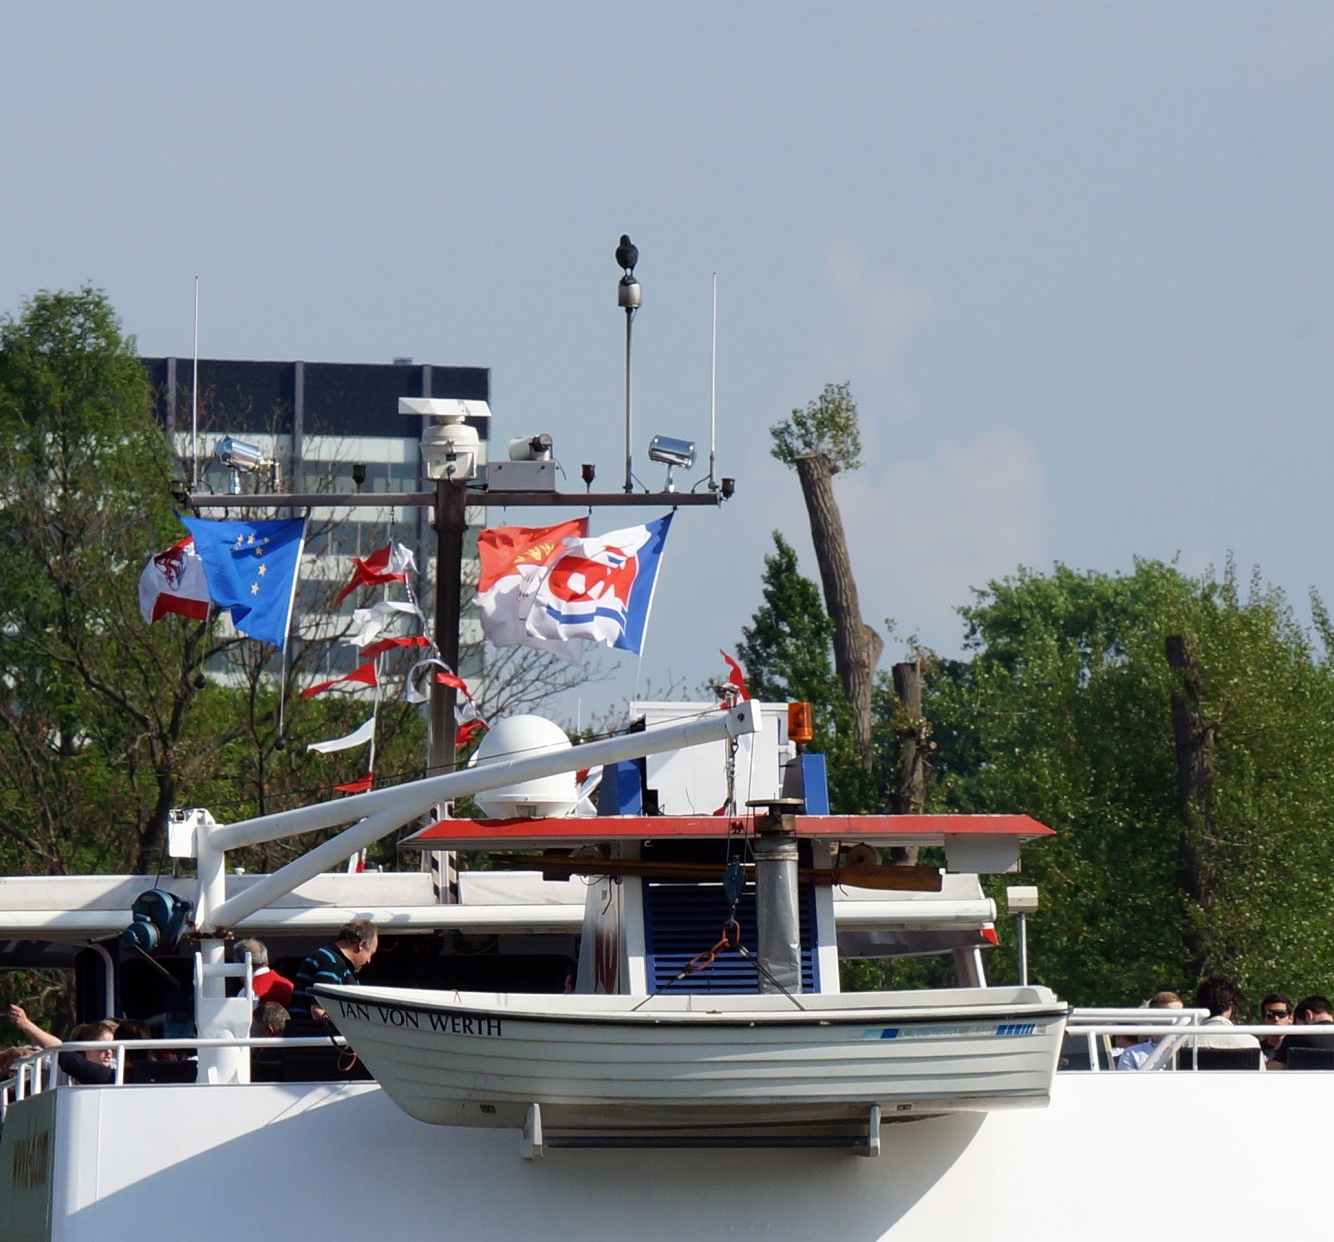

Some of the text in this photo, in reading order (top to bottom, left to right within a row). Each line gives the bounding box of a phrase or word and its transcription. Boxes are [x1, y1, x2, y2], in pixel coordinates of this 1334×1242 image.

[338, 1000, 502, 1037] JAN VON WERTH
